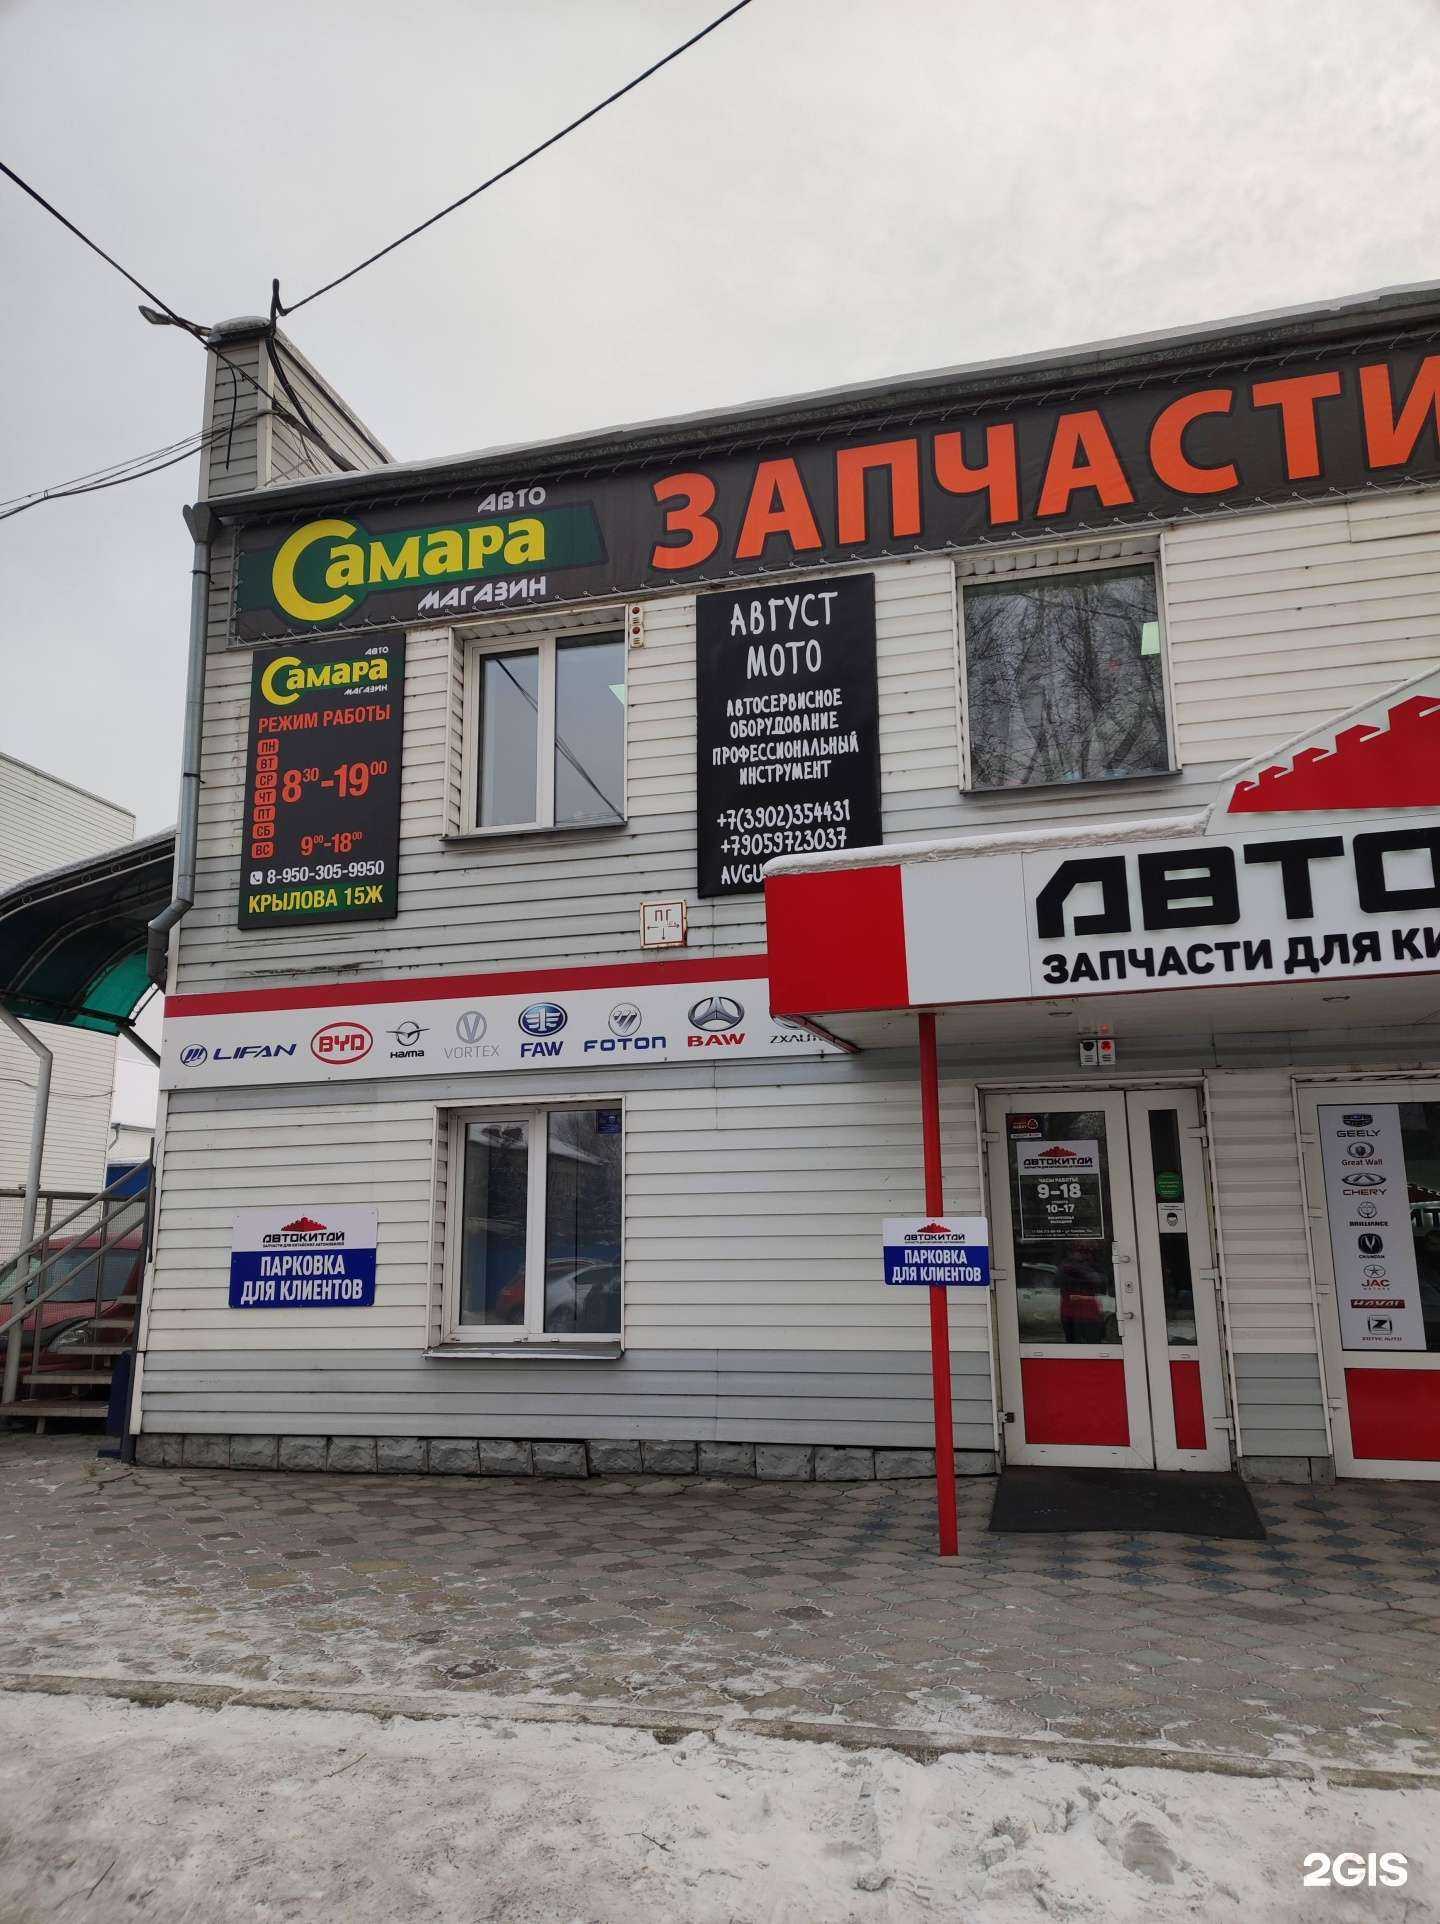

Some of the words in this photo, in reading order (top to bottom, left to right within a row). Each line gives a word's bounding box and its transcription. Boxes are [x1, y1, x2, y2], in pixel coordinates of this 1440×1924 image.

[651, 354, 1440, 570] ЗАПЧАСТИ
[478, 486, 546, 512] АВТО
[418, 575, 546, 612] МАГАЗИН
[731, 592, 839, 636] АВГУСТ
[365, 646, 389, 655] АВТО
[747, 639, 822, 679] МОТО
[344, 683, 388, 696] МАГАЗИН
[727, 688, 843, 718] АВТОСЕРВИСНОЕ
[258, 709, 318, 733] РЕЖИМ
[322, 704, 391, 729] РАБОТЫ
[730, 711, 839, 739] ОБОРУДОВАНИЕ
[260, 741, 277, 754] ПН
[712, 731, 859, 765] ПРОФЕССИОНАЛЬНЫЙ
[260, 757, 276, 770] ВТ
[259, 774, 275, 786] СР
[739, 760, 831, 786] ИНСТРУМЕНТ
[258, 790, 274, 803] ЧТ
[257, 808, 272, 820] ПТ
[717, 799, 850, 832] +7(3902)354431
[255, 825, 272, 838] СБ
[255, 843, 271, 856] ВС
[721, 827, 847, 856] +79059723037
[267, 860, 385, 885] 8-950-305-9950
[1036, 826, 1440, 939] АВТО
[248, 887, 338, 914] КРЫЛОВА
[344, 884, 383, 905] 15Ж
[654, 908, 673, 923] ПГ
[1042, 938, 1273, 985] ЗАПЧАСТИ
[1285, 931, 1382, 975] ДЛЯ
[318, 1033, 365, 1053] BYD
[520, 1041, 563, 1058] FAW
[584, 1036, 667, 1053] FOTON
[687, 1033, 746, 1048] BAW
[213, 1043, 297, 1061] LIFAN
[444, 1045, 501, 1059] VORTEX
[1337, 1130, 1381, 1138] GEELY
[1366, 1158, 1383, 1166] Wall
[263, 1230, 345, 1243] АВТОКИТАЙ
[261, 1254, 346, 1277] ПАРКОВКА
[904, 1249, 968, 1264] ПАРКОВКА
[892, 1266, 917, 1283] ДЛЯ
[920, 1266, 982, 1282] КЛИЕНТОВ
[240, 1281, 275, 1305] ДЛЯ
[280, 1279, 363, 1301] КЛИЕНТОВ
